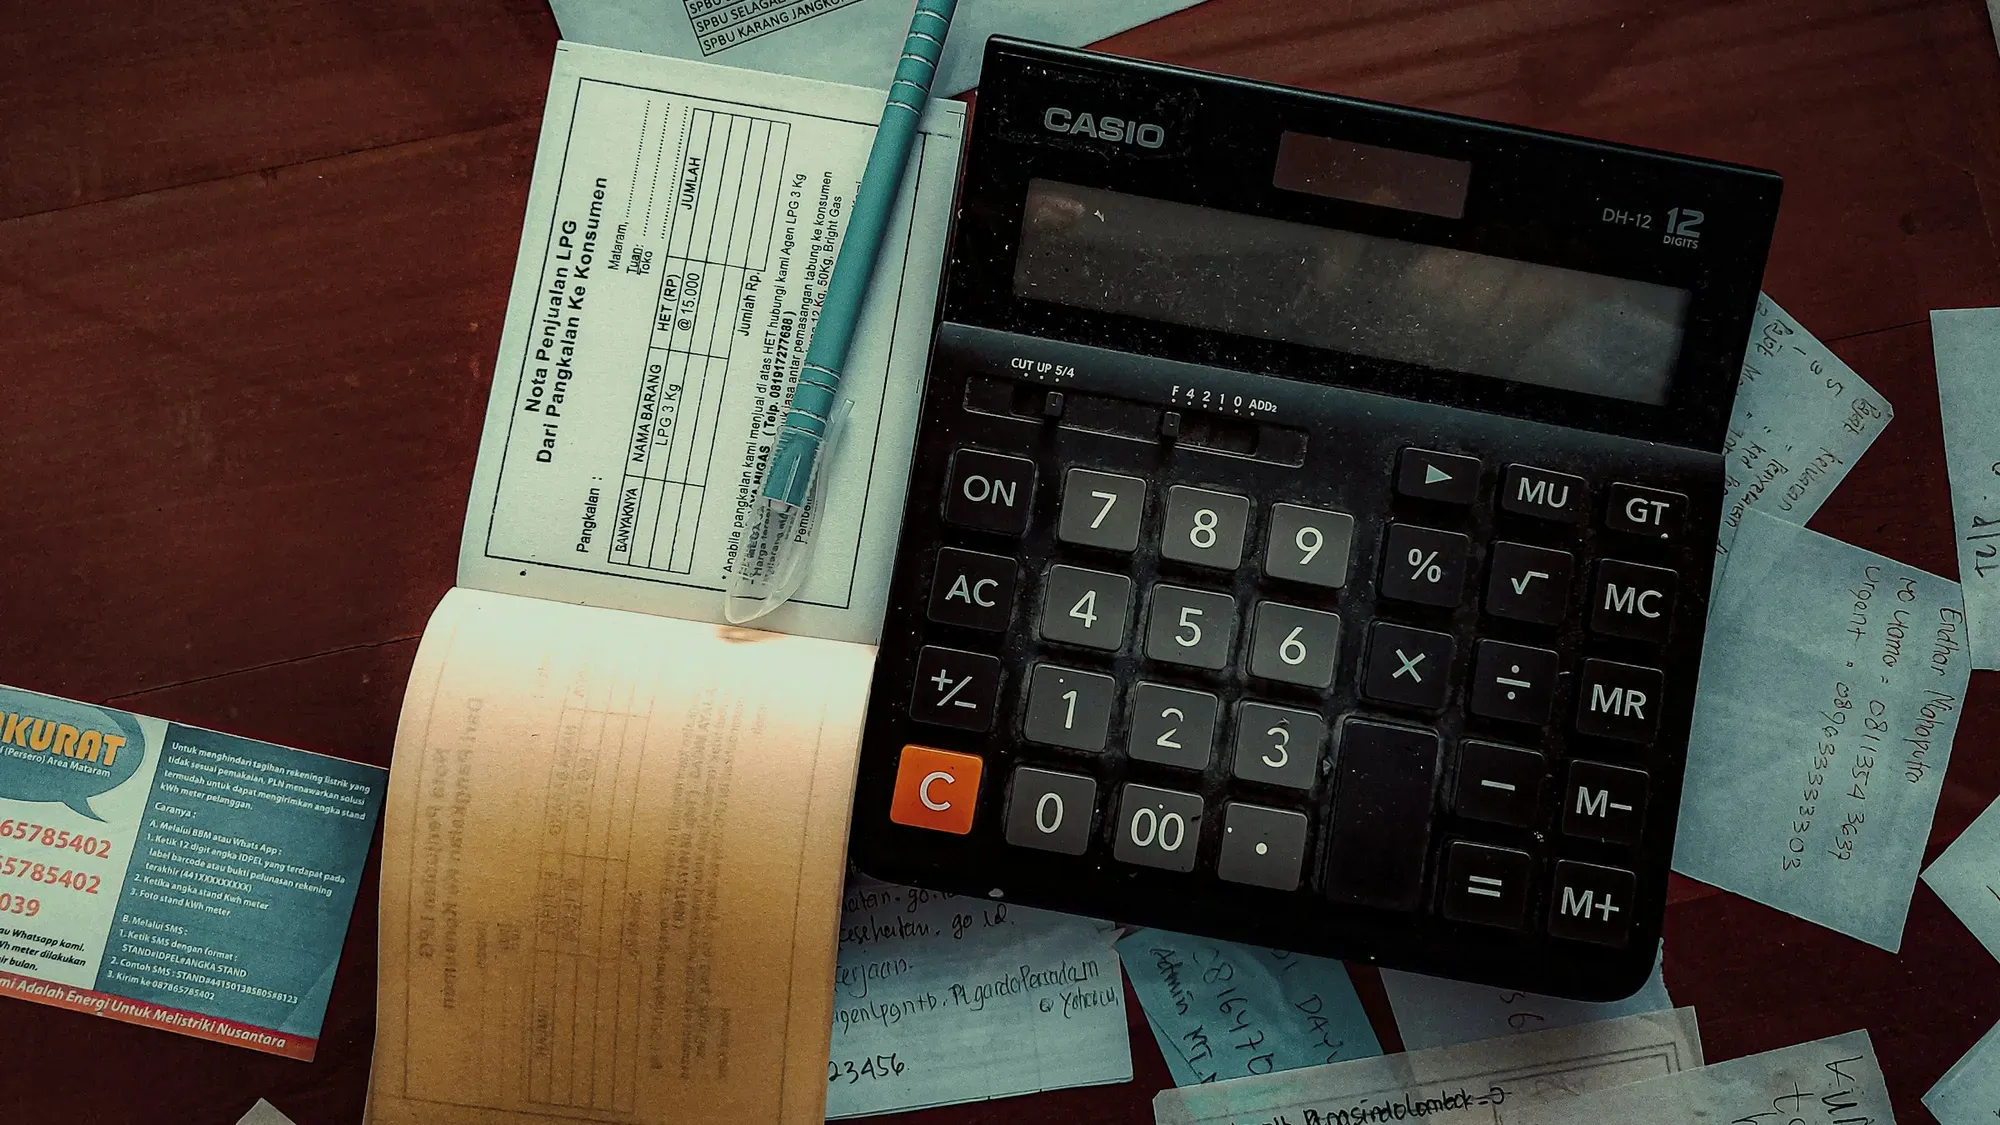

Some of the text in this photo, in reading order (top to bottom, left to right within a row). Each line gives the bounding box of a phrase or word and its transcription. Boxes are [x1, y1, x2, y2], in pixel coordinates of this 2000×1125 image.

[696, 12, 728, 32] SPBU
[703, 30, 735, 51] SPBU
[736, 11, 789, 38] KARANG
[1044, 106, 1165, 150] CASIO
[680, 156, 701, 210] JUMLAH
[790, 190, 801, 198] 3
[791, 173, 807, 188] Kg
[813, 171, 832, 226] konsumen
[785, 200, 799, 224] LPG
[829, 196, 842, 218] Gas
[1602, 207, 1652, 229] DH-12
[1665, 207, 1704, 239] 12
[607, 221, 629, 270] Mataram,
[780, 227, 795, 256] Agen
[810, 228, 823, 242] ke
[822, 220, 838, 252] Bright
[1663, 235, 1700, 249] DIGITS
[638, 250, 653, 276] Toko
[774, 256, 790, 283] kami
[803, 244, 822, 281] tabung
[524, 220, 577, 412] Nota Penjualan LPG
[656, 274, 681, 331] HET (RP)
[677, 272, 700, 331] @ 15.000
[737, 272, 762, 336] Jumlah Rp.
[766, 284, 787, 328] hubungi
[793, 284, 813, 353] pemasangan
[535, 177, 607, 463] Dari Pangkalan Ke Konsumen
[762, 329, 776, 355] HET
[759, 357, 772, 381] atas
[788, 354, 801, 384] antar
[1011, 357, 1074, 380] CUT UP 5/4
[756, 382, 767, 393] di
[1171, 385, 1179, 396] F
[1186, 388, 1195, 399] 4
[1202, 390, 1211, 402] 2
[1220, 393, 1225, 404] 1
[1233, 395, 1242, 407] 0
[631, 364, 662, 462] NAMA BARANG
[654, 383, 681, 446] LPG 3 Kg
[749, 395, 765, 439] menjual
[763, 401, 780, 428] Telp.
[741, 441, 757, 468] kami
[733, 471, 752, 528] pangkalan
[963, 475, 1016, 507] ON
[1517, 474, 1572, 510] MU
[575, 487, 600, 553] Pangkalan
[614, 487, 638, 552] BANYAKNYA
[1090, 491, 1117, 528] 7
[1625, 497, 1670, 525] GT
[1189, 509, 1218, 548] 8
[1295, 527, 1323, 564] 9
[1408, 548, 1441, 583] %
[944, 574, 999, 607] AC
[1604, 583, 1663, 618] MC
[1069, 590, 1097, 628] 4
[1175, 606, 1202, 646] 5
[1279, 626, 1306, 665] 6
[1062, 690, 1077, 729] 1
[1590, 683, 1646, 720] MR
[1156, 707, 1183, 748] 2
[1261, 727, 1289, 767] 3
[46, 756, 68, 768] Area
[69, 760, 110, 778] Mataram
[267, 777, 285, 788] PLN
[917, 769, 958, 813] C
[1035, 792, 1063, 833] 0
[1131, 805, 1184, 851] 00
[1560, 886, 1619, 922] M+
[10, 945, 40, 956] meter
[39, 949, 86, 966] dilakukan
[12, 928, 58, 947] Whatsapp
[8, 956, 38, 971] bulan.
[15, 980, 286, 1048] Adalah Energi Untuk Melistriki Nusantara
